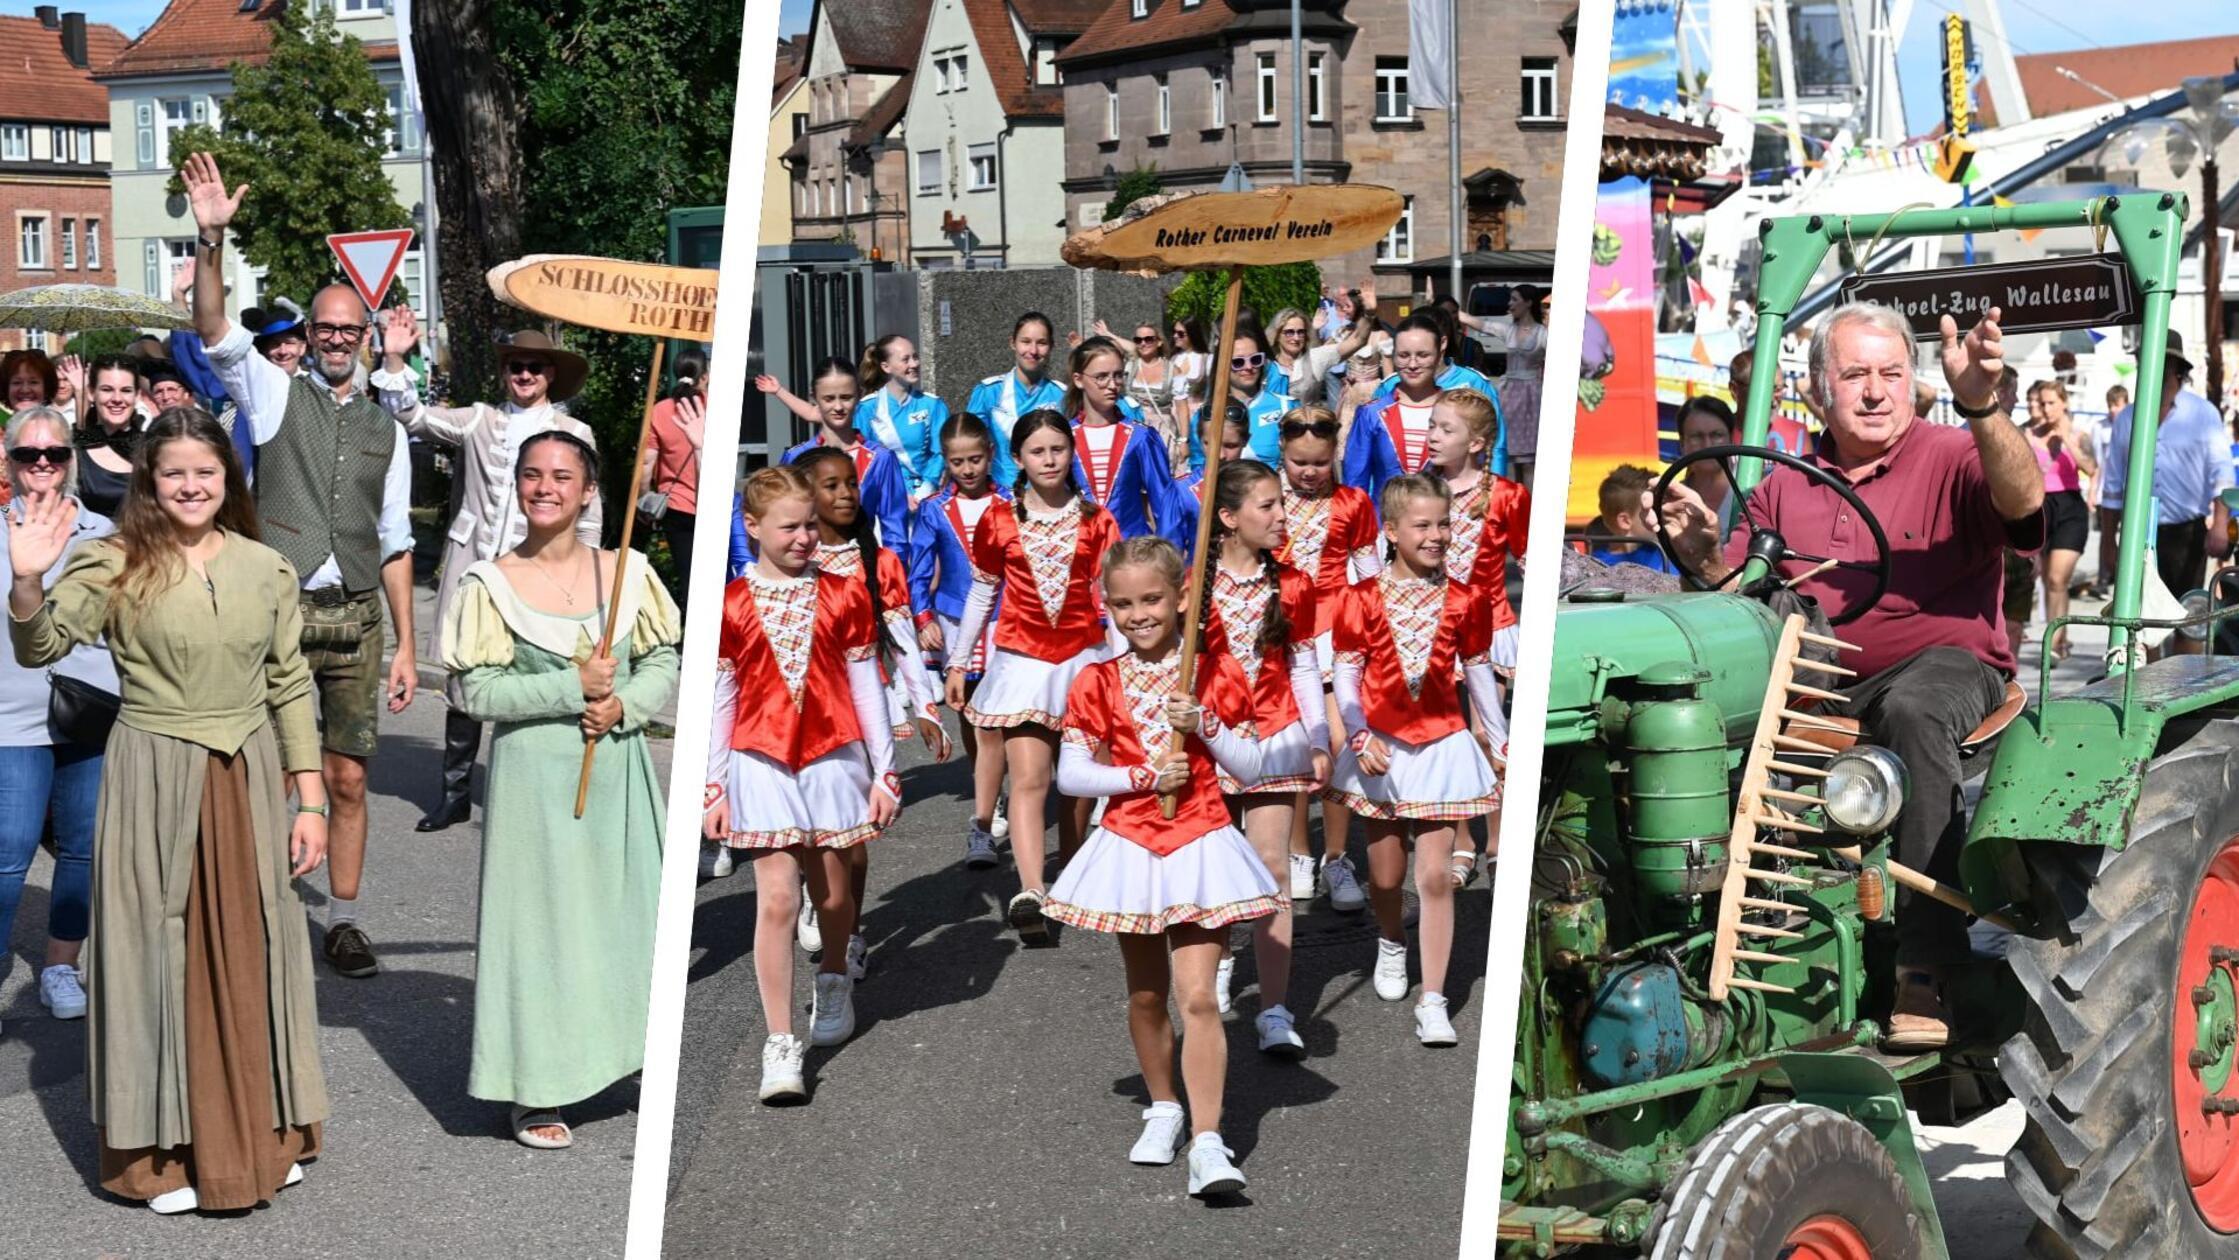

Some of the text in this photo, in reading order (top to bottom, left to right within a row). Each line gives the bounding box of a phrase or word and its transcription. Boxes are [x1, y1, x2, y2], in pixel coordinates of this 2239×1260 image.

[1155, 219, 1333, 249] Rother Carneval Verein
[2007, 282, 2110, 307] Wallesau
[629, 302, 711, 333] ROTH
